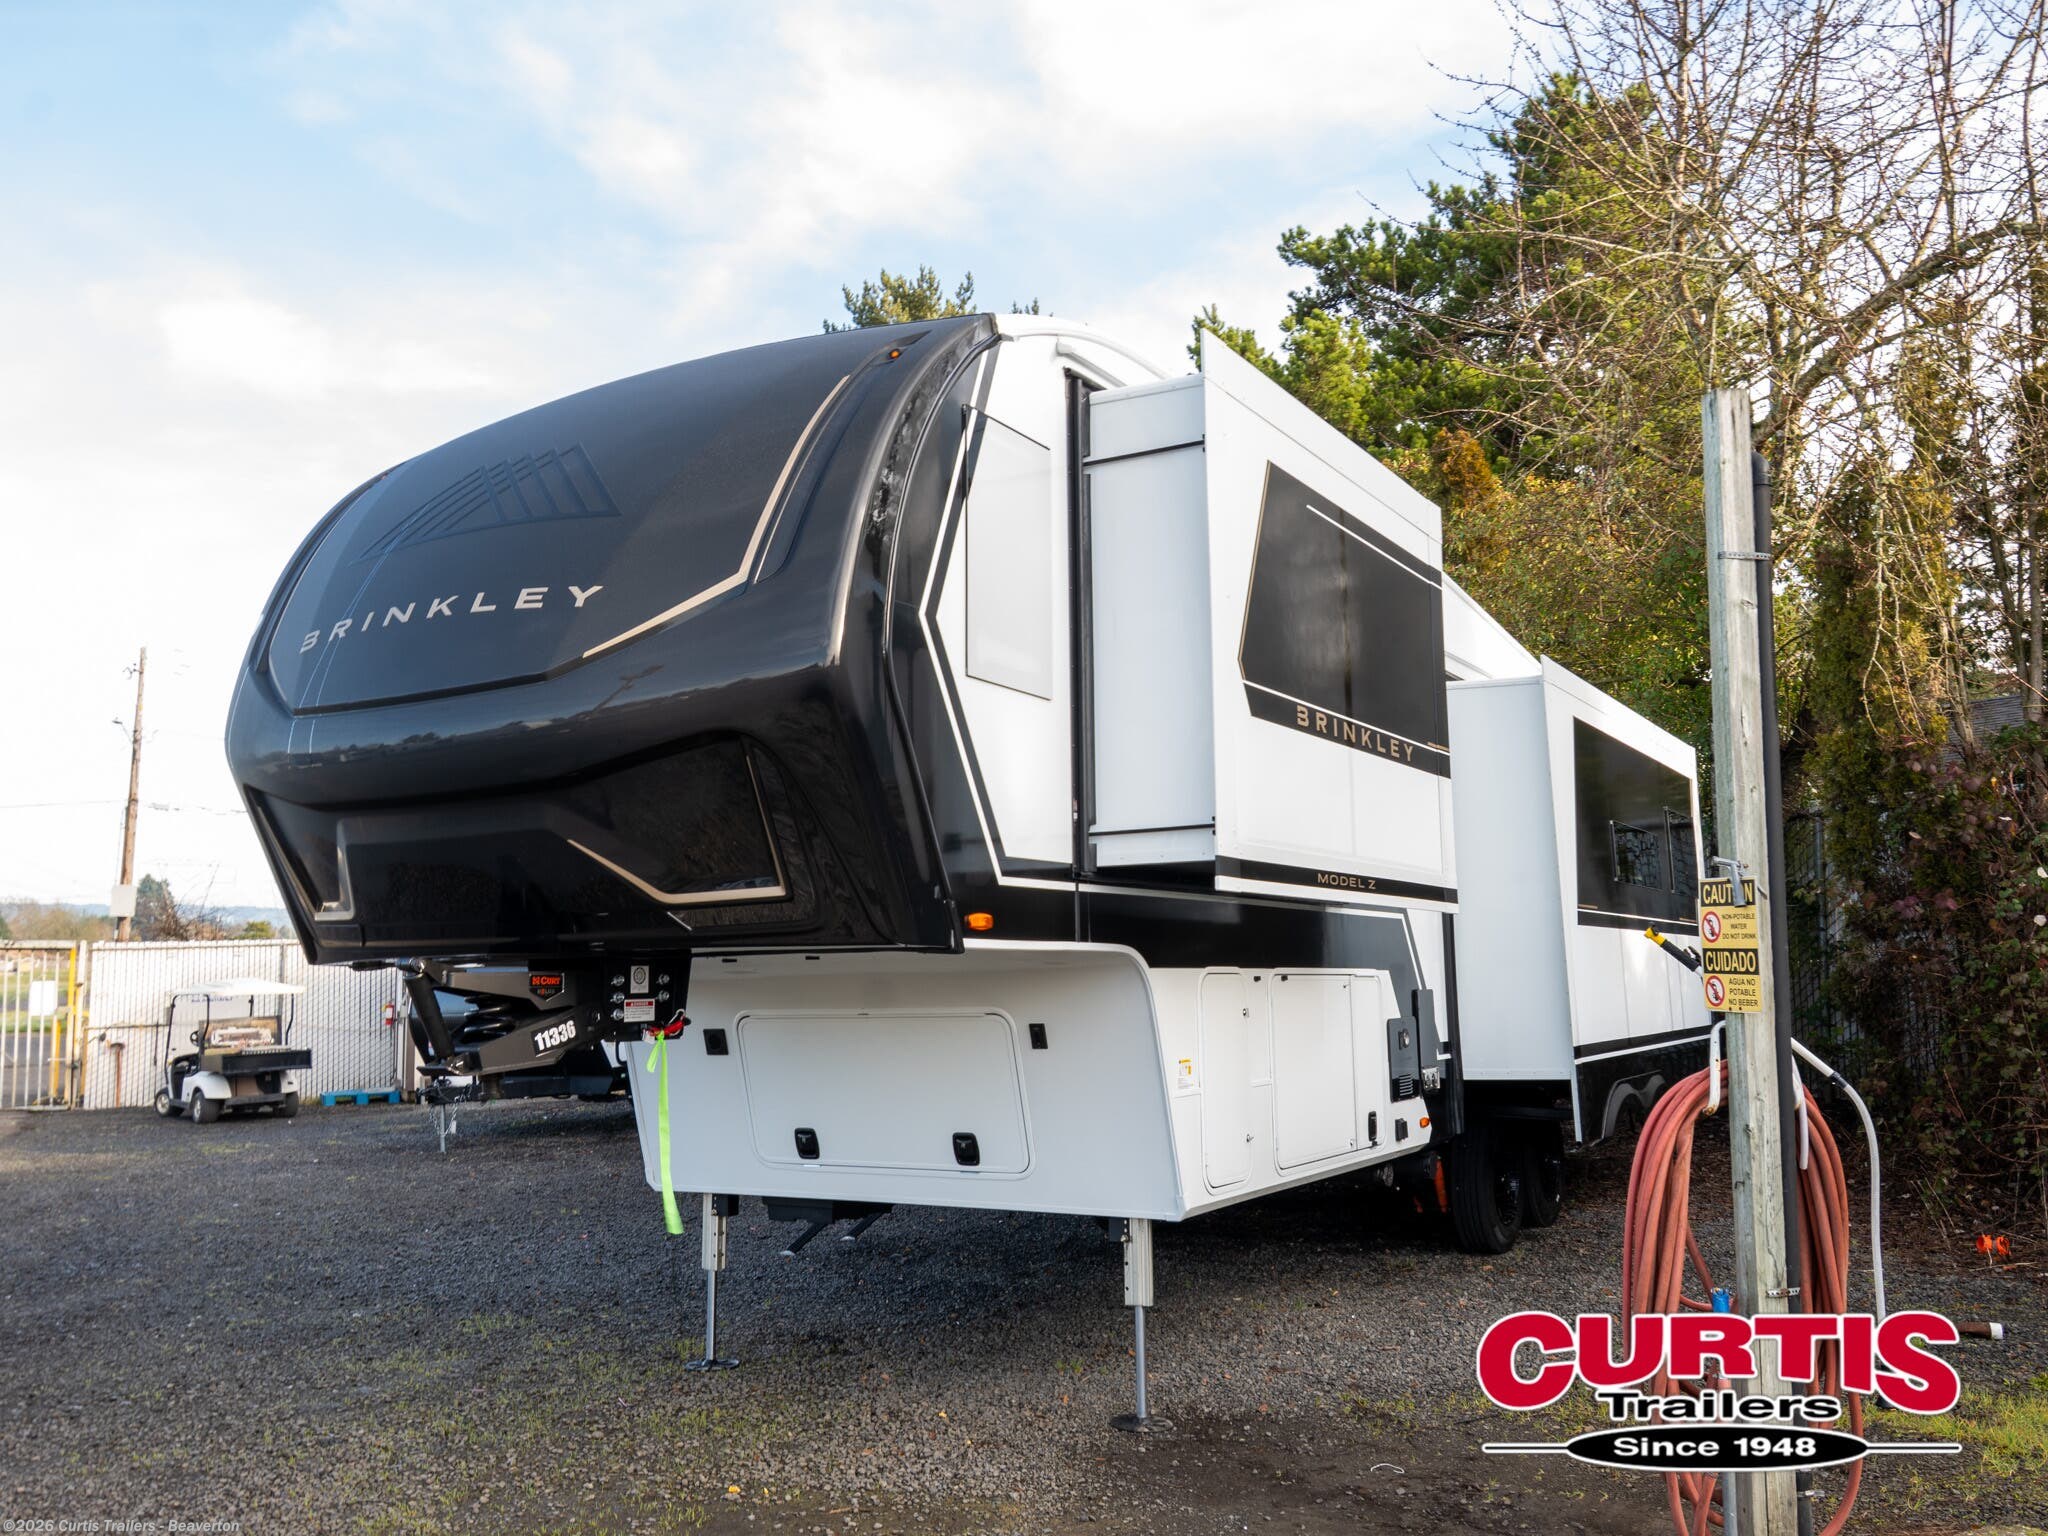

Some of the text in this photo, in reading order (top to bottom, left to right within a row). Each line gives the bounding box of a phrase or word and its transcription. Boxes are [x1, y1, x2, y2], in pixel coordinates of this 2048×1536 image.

[300, 585, 604, 654] BRINKLEY
[1296, 705, 1414, 762] BRINKLEY
[1317, 873, 1376, 890] MODEL Z
[1703, 882, 1753, 904] CAUTN
[1705, 951, 1757, 972] CUIDADO
[1729, 978, 1756, 986] AGUA NO
[1729, 988, 1756, 997] POTABLE
[1738, 999, 1758, 1007] BEBER
[534, 1020, 577, 1051] 11336
